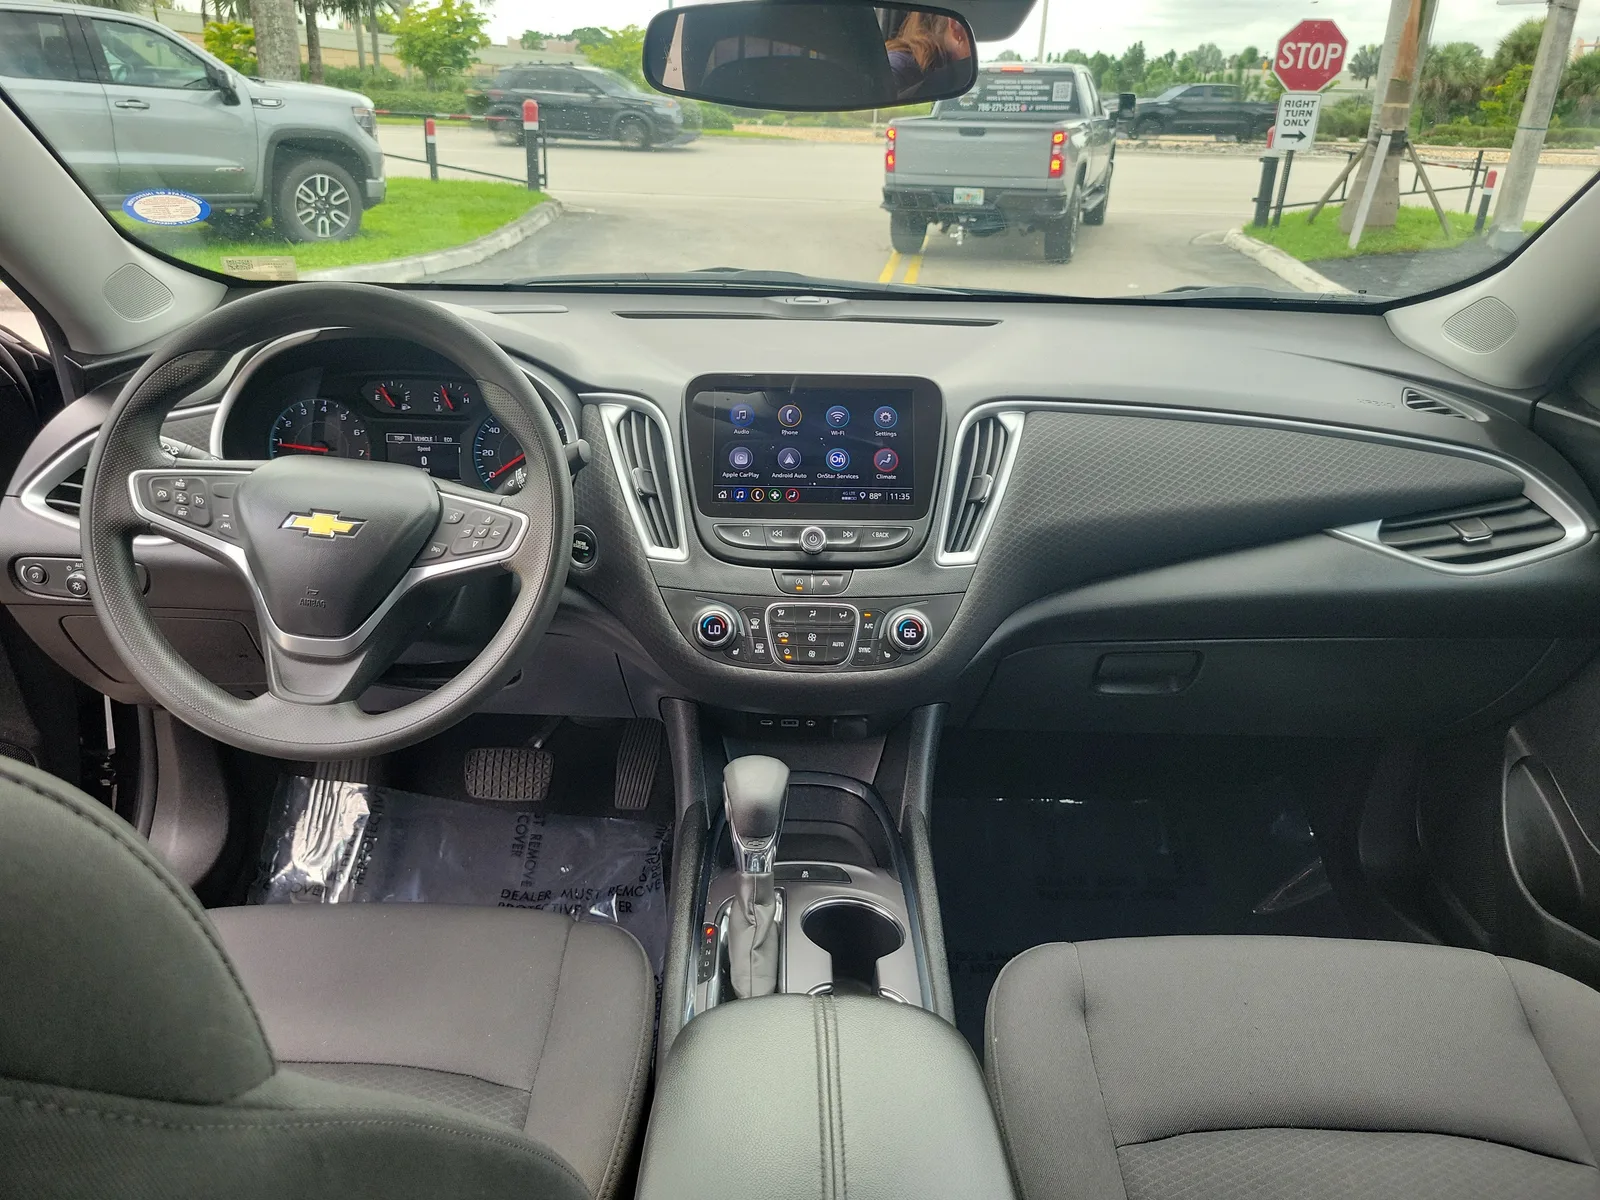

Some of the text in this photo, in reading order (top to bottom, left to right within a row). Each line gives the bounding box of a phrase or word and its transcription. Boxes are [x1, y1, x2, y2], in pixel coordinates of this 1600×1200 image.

[1278, 41, 1342, 70] STOP
[1284, 99, 1317, 109] RIGHT
[1285, 109, 1313, 118] TURN
[1283, 118, 1310, 127] ONLY
[421, 456, 428, 466] 0
[299, 598, 327, 608] AIRBAG
[708, 624, 720, 635] LO
[904, 628, 917, 638] 66
[510, 814, 530, 858] COVER
[500, 888, 552, 901] DEALER
[560, 888, 601, 901] MUST
